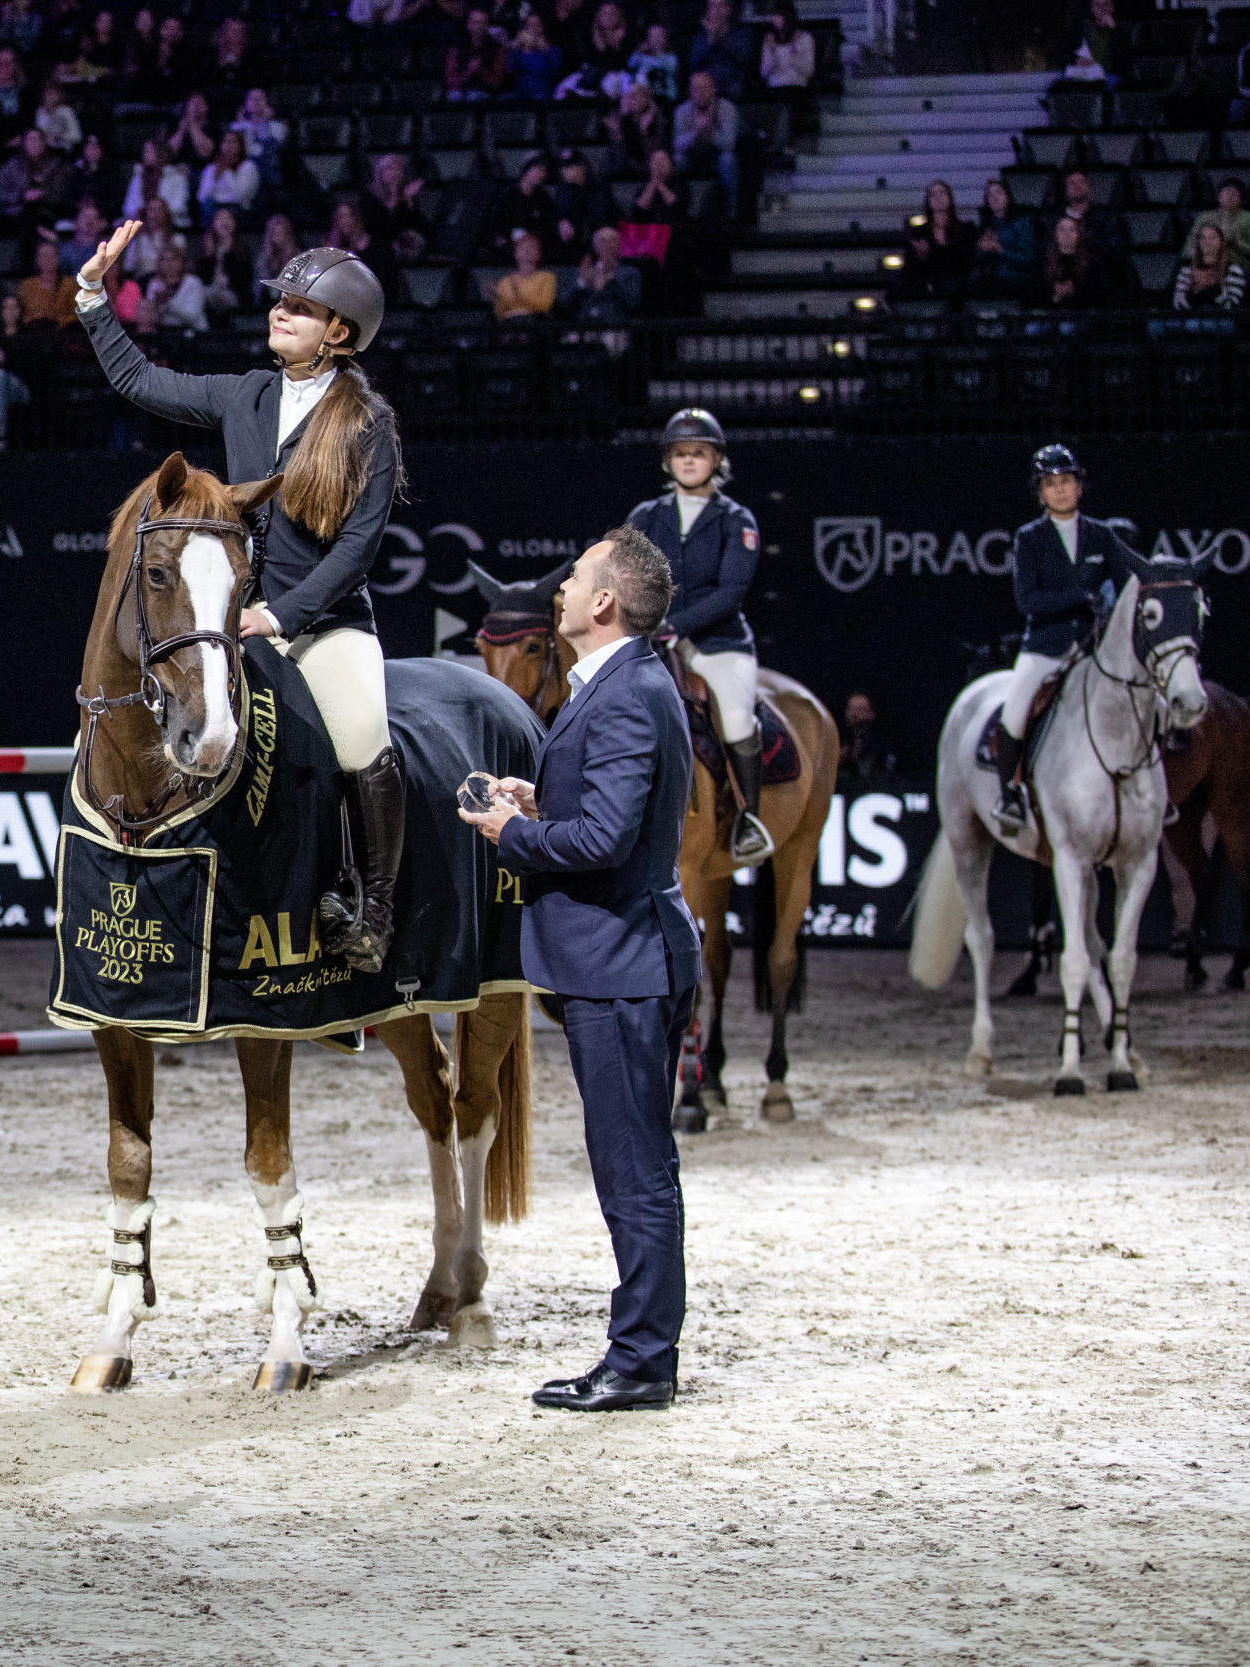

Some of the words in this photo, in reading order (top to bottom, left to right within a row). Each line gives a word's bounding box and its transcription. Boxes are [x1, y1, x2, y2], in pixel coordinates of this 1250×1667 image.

[884, 531, 1016, 576] PRAG
[91, 908, 162, 941] PRAGUE
[75, 926, 175, 964] PLAYOFFS
[97, 956, 143, 985] 2023
